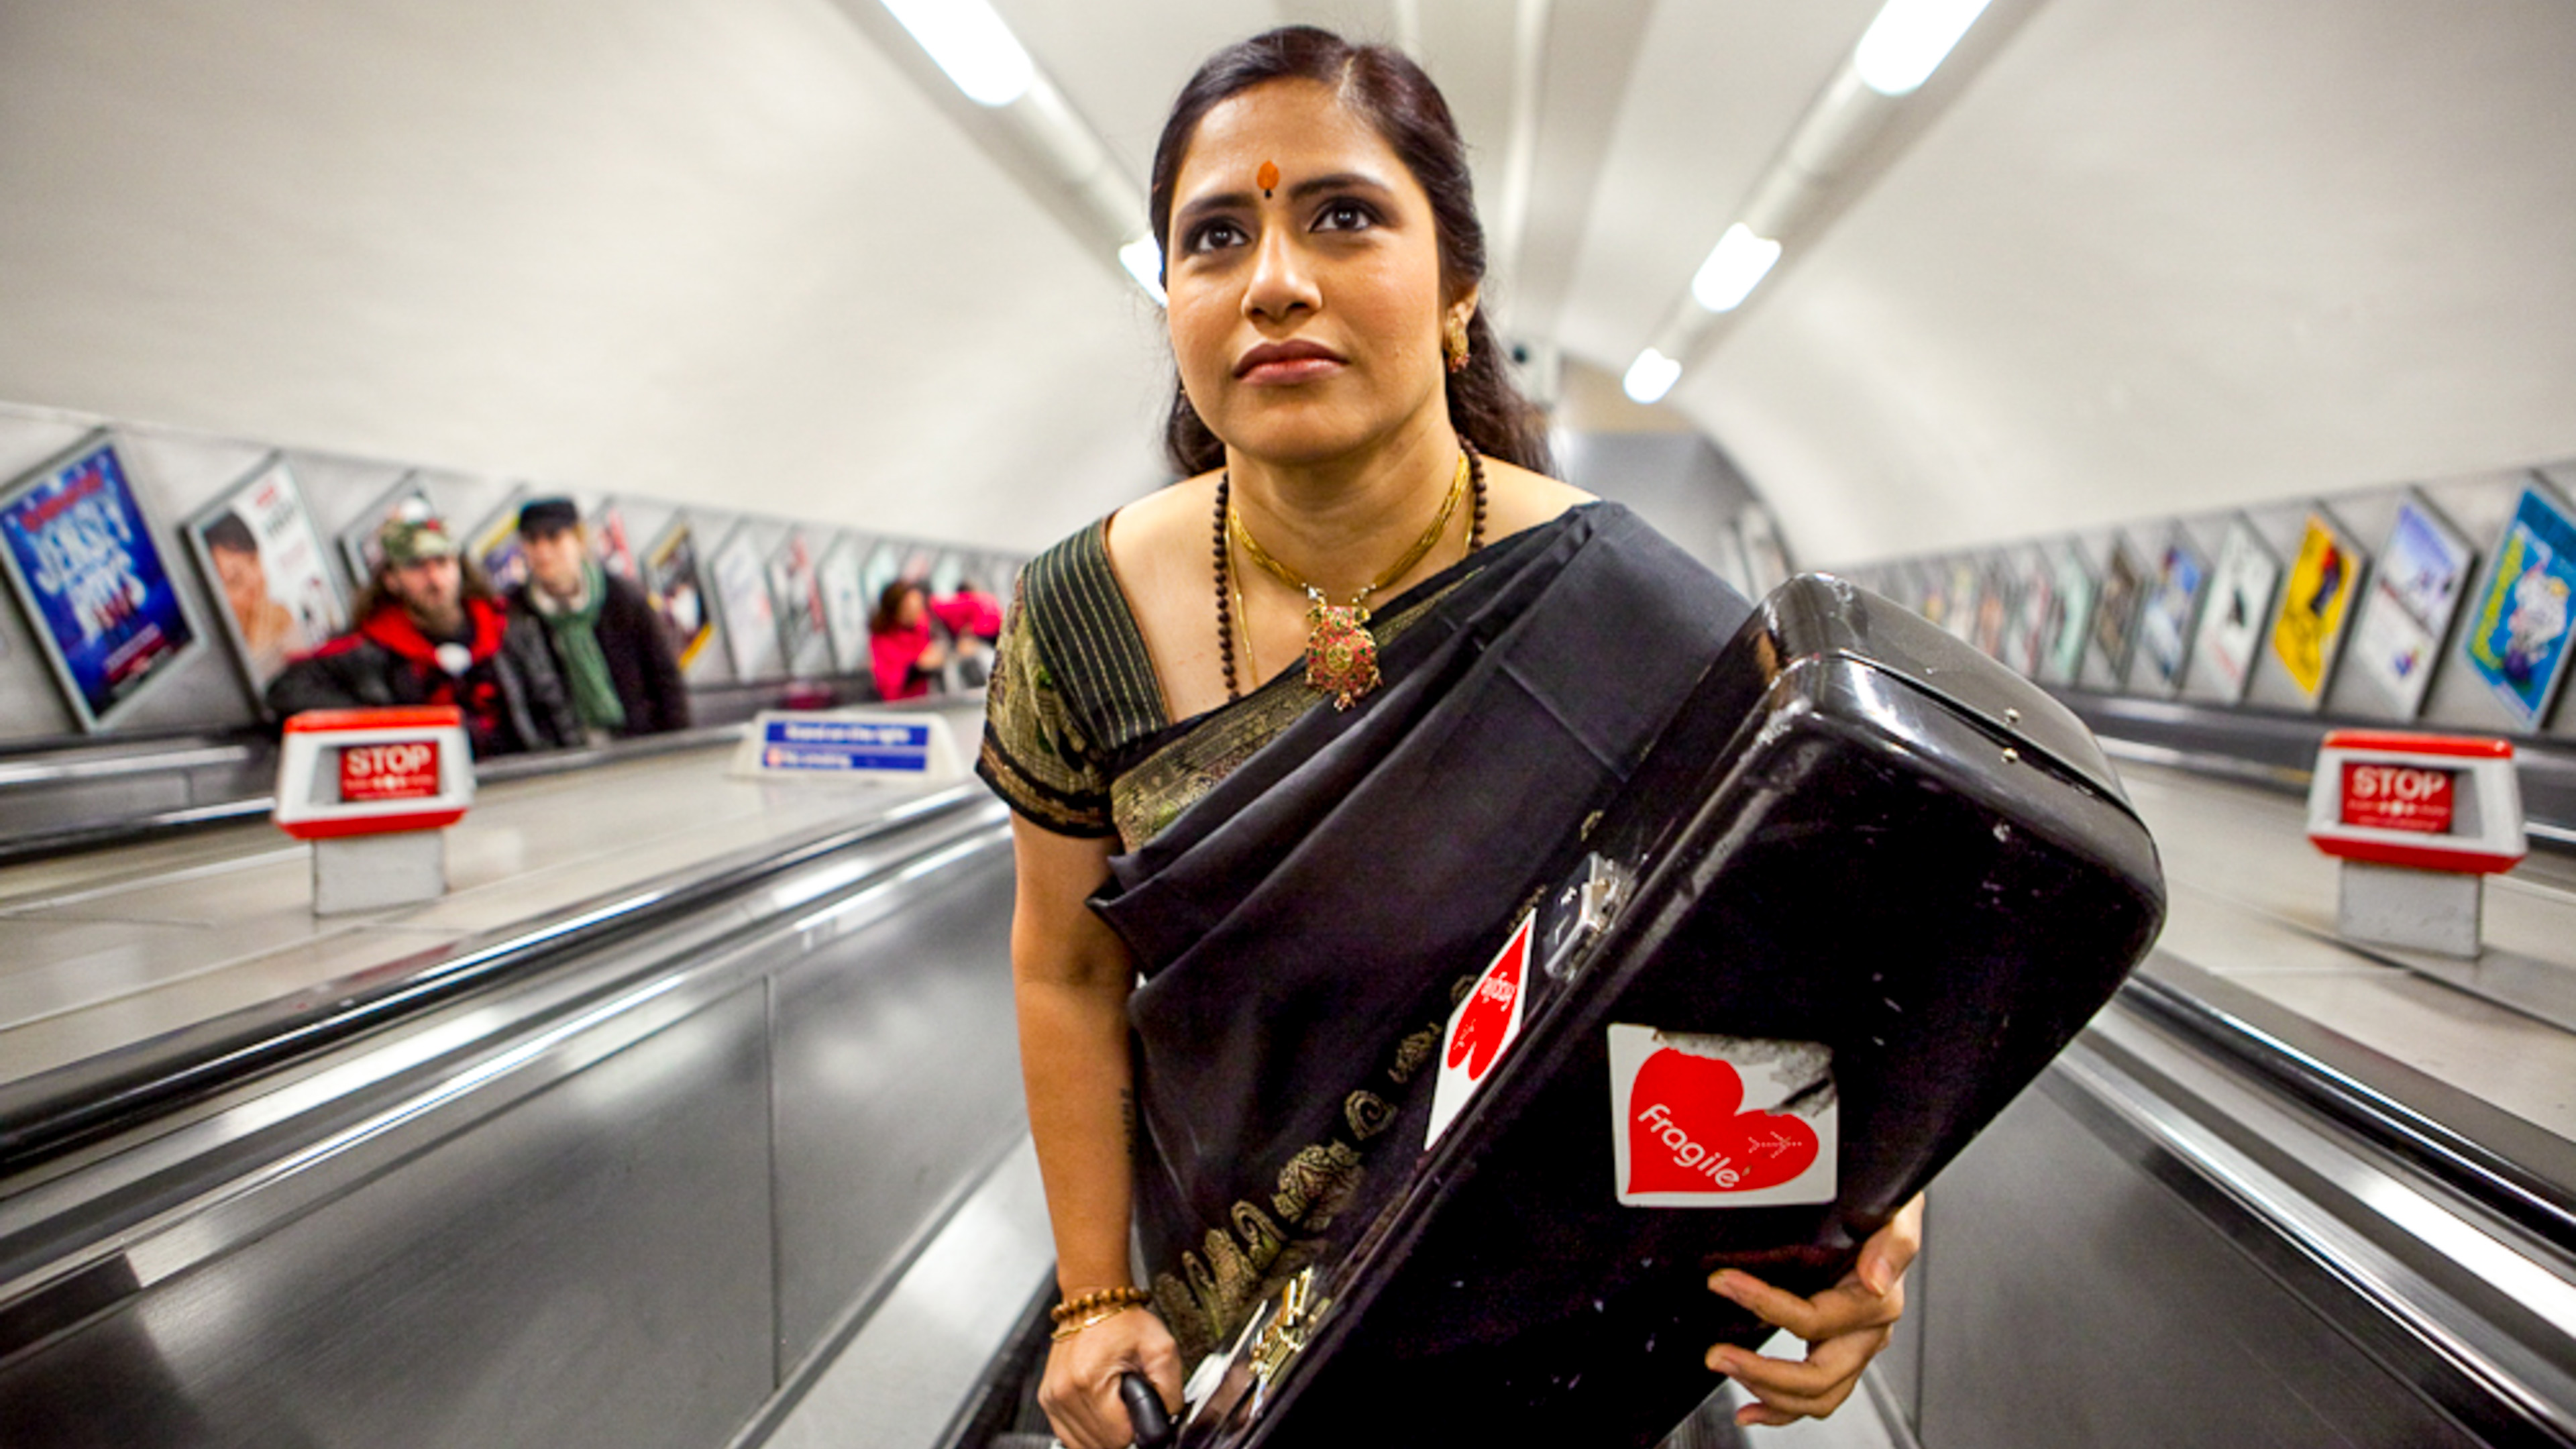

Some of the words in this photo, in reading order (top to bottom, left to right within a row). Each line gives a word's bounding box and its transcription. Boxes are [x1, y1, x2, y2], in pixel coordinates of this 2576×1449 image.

[346, 745, 432, 778] STOP
[2351, 765, 2447, 801] STOP
[1637, 1103, 1740, 1189] Fragile
